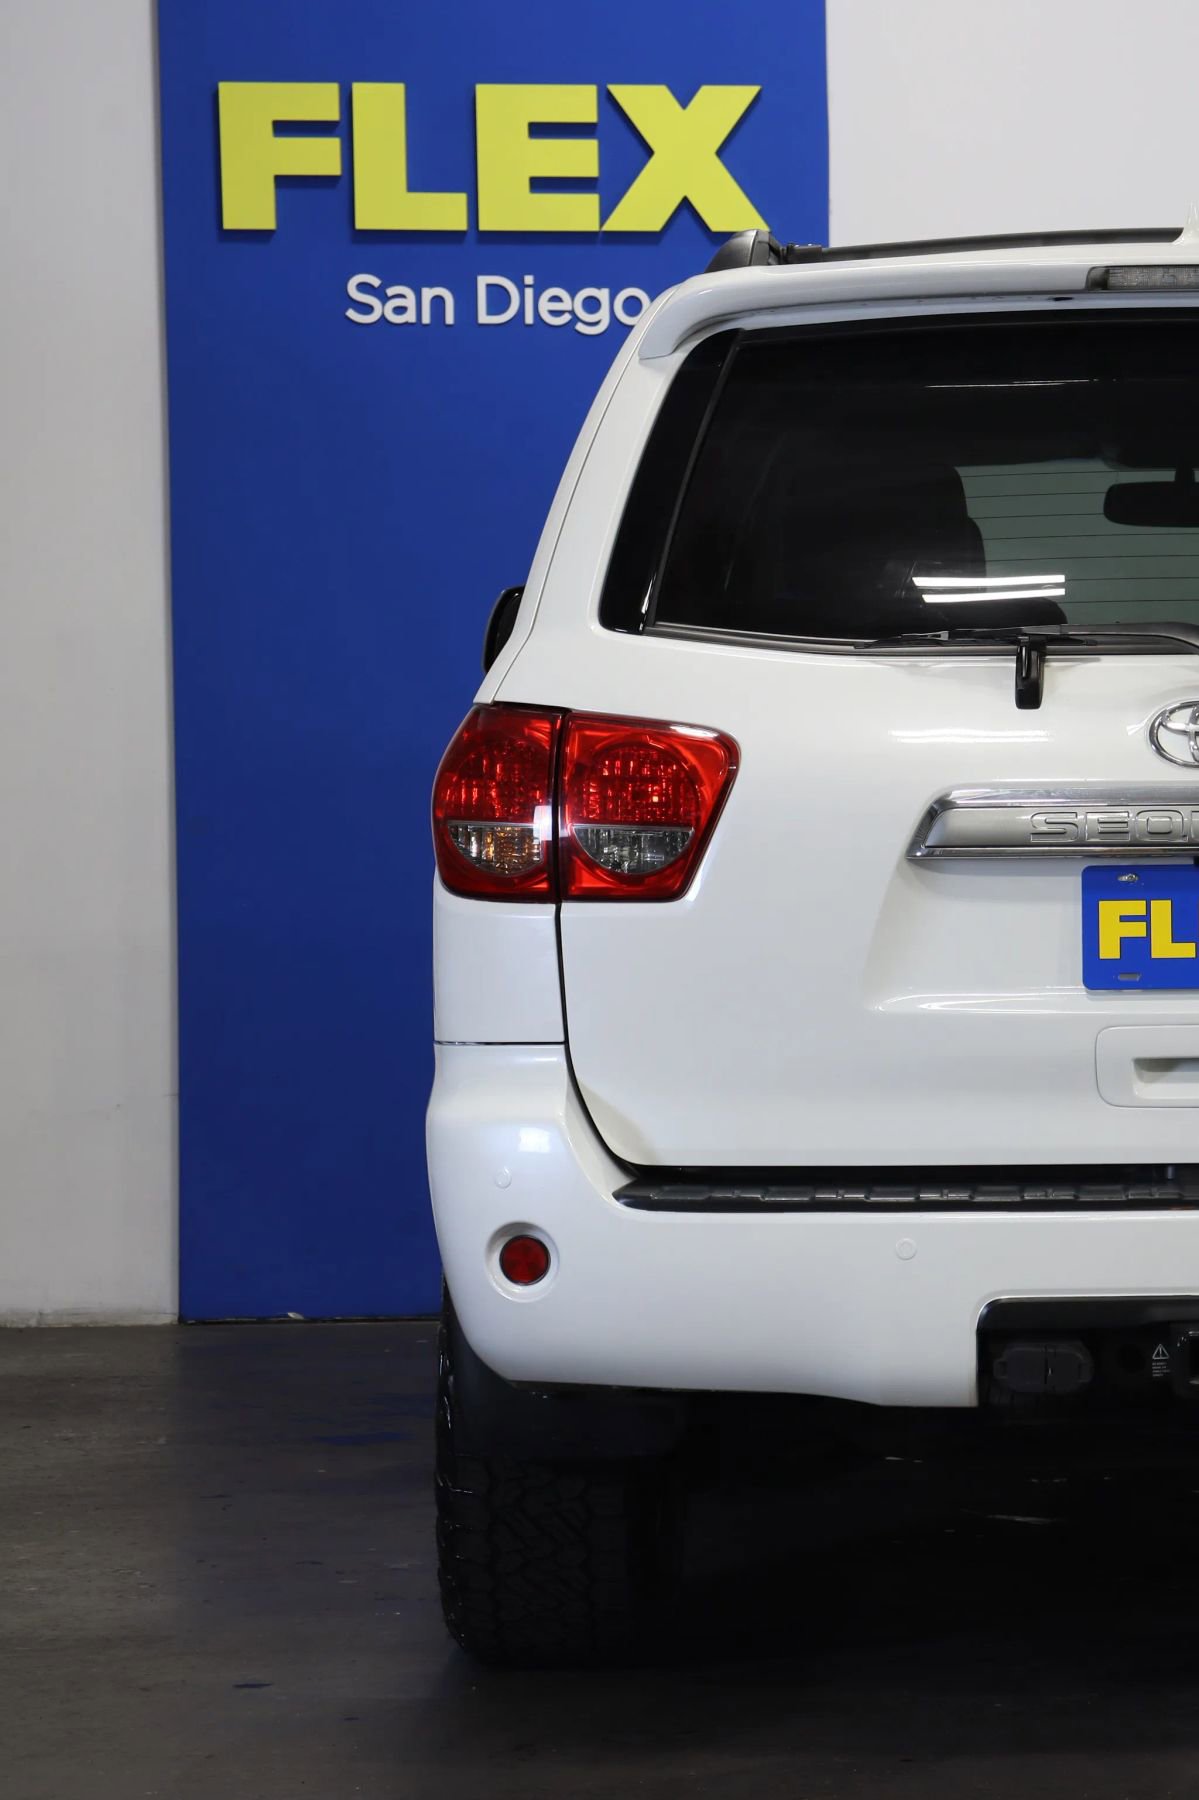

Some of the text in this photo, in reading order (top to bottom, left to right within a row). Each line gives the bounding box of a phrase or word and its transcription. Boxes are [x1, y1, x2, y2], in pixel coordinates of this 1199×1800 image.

[218, 82, 770, 232] FLEX
[345, 274, 651, 336] San Diego
